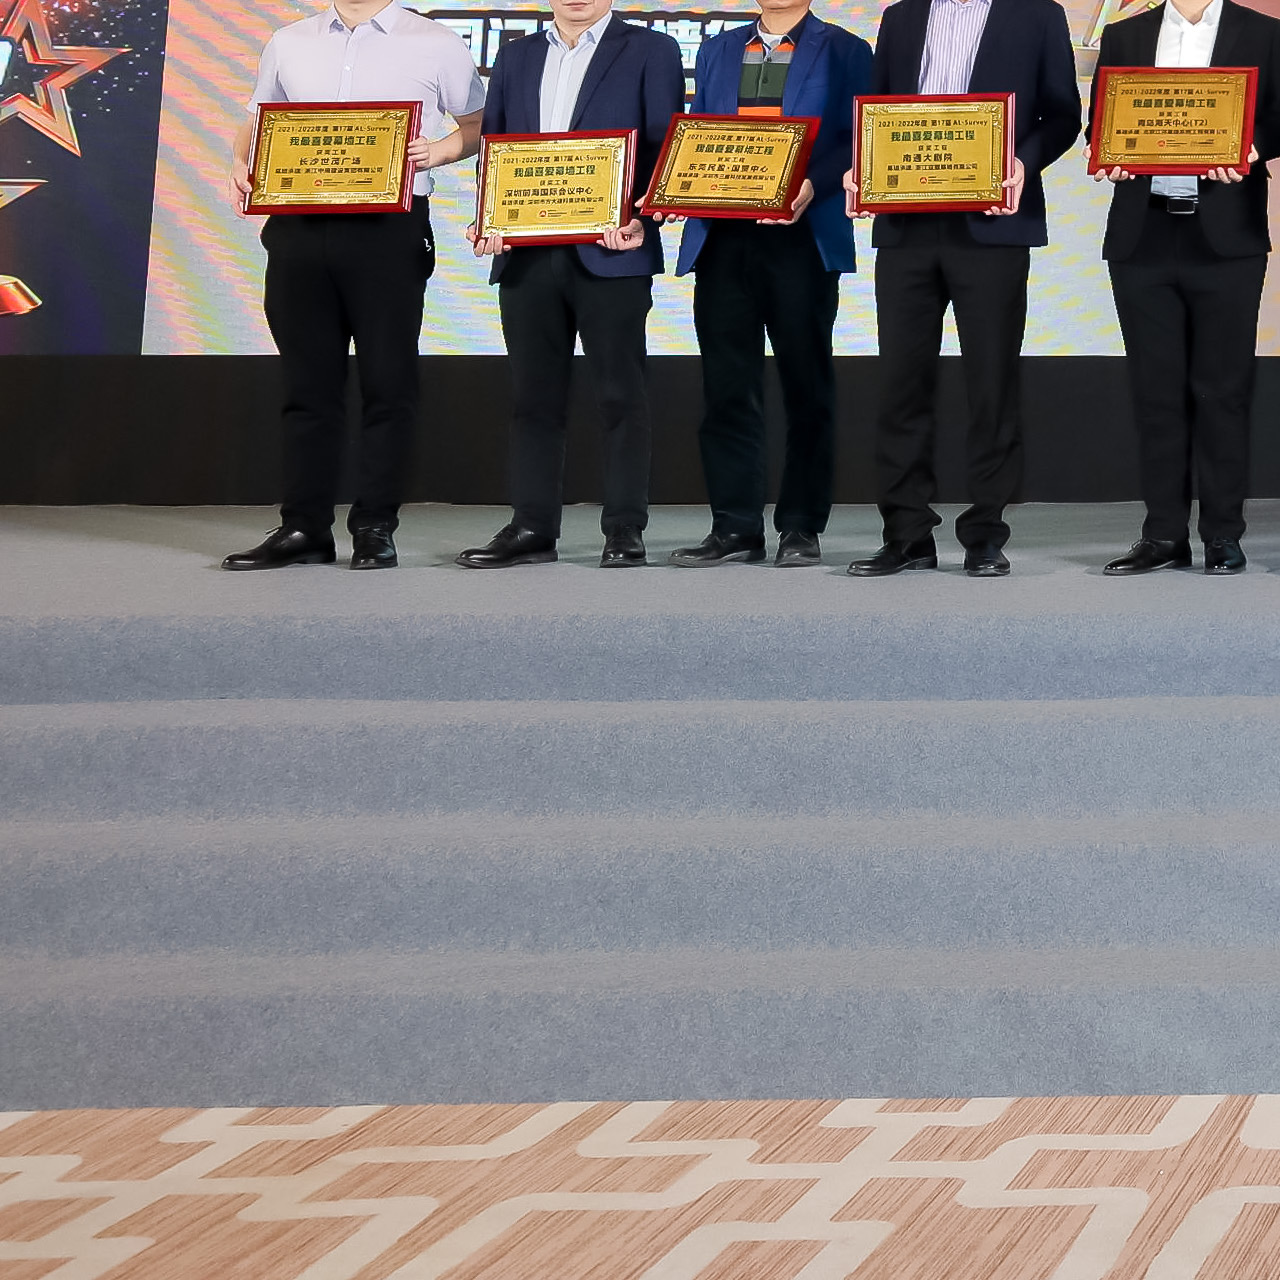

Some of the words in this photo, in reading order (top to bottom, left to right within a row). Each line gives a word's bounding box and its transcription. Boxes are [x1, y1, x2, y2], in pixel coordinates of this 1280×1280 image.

[1133, 99, 1216, 108] 我最喜爱幕墙工程
[290, 136, 376, 146] 我最喜爱幕墙工程
[891, 130, 975, 142] 我最喜爱幕墙工程
[695, 144, 774, 155] 我最喜爱幕墙工程
[514, 165, 595, 177] 我最喜爱幕墙工程
